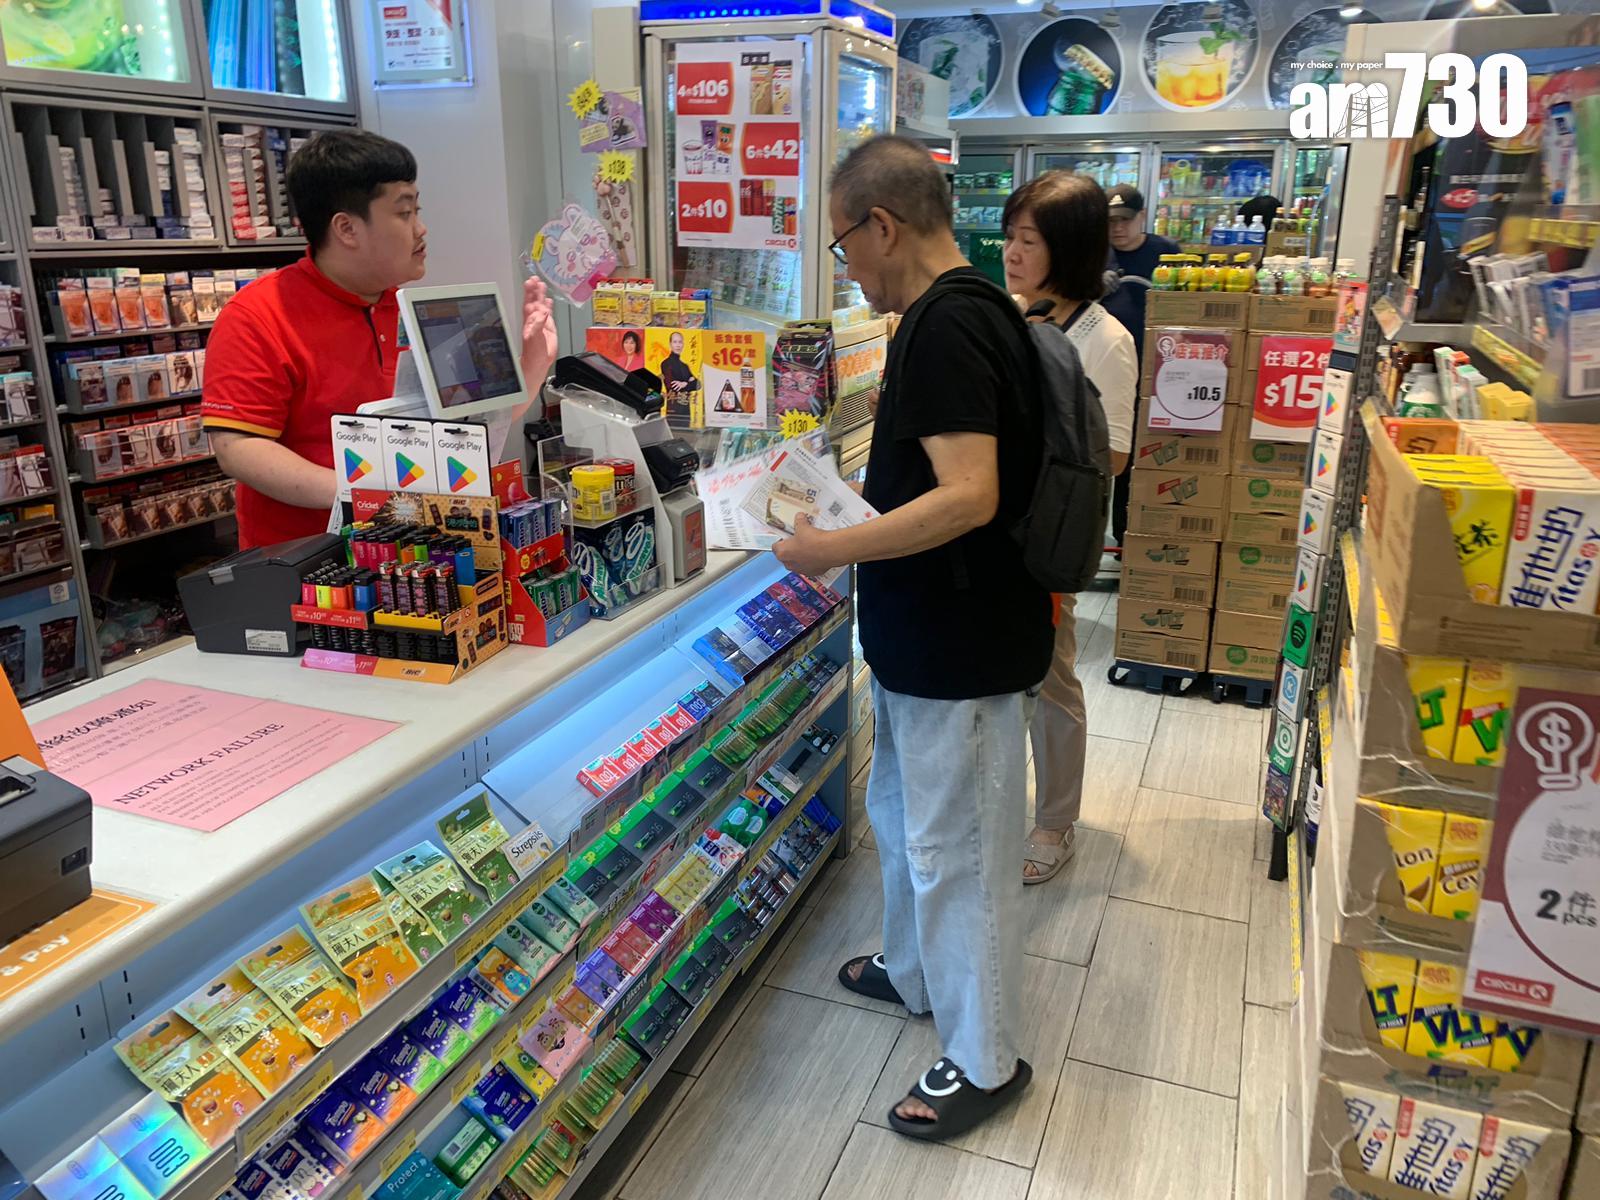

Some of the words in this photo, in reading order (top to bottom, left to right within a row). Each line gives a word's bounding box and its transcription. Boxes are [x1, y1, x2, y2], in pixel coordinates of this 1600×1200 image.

[1175, 343, 1229, 361] 店長推介
[1188, 386, 1220, 401] $10.5
[1264, 374, 1324, 408] $15
[336, 431, 362, 443] Google
[362, 433, 376, 444] Play
[788, 420, 808, 432] $130
[387, 435, 412, 447] Google
[414, 437, 429, 448] Play
[438, 439, 464, 451] Google
[466, 441, 482, 452] Play
[357, 501, 380, 510] Cricket
[113, 756, 212, 805] NETWORK
[208, 722, 286, 759] FAILURE
[511, 830, 544, 858] Strepsils
[1536, 888, 1562, 920] 2
[1562, 912, 1598, 928] pcs
[20, 934, 70, 963] Pay
[1481, 976, 1528, 994] CIRCLE
[390, 1043, 411, 1066] Tempo
[360, 1070, 382, 1094] Tempo
[324, 1100, 348, 1126] Tempo
[148, 1138, 190, 1178] 003
[387, 1162, 419, 1194] Protect
